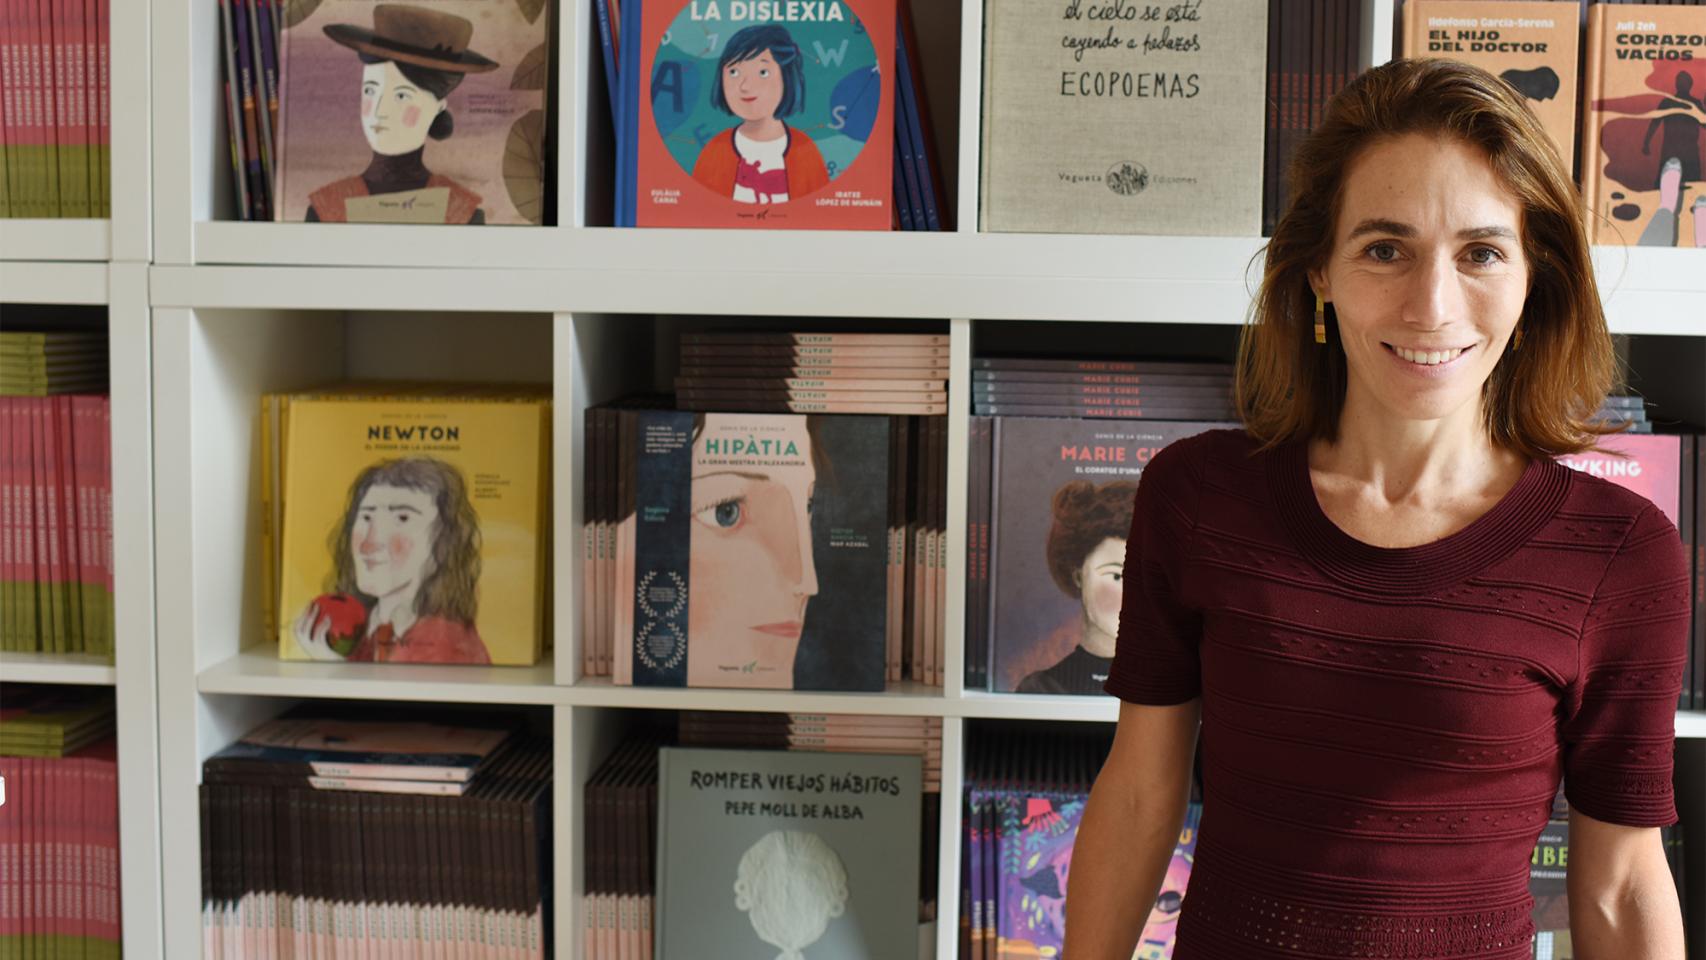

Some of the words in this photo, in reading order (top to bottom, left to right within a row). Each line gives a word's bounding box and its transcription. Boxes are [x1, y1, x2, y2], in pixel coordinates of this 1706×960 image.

[691, 0, 721, 21] LA
[730, 1, 843, 22] DISLEXIA
[1063, 0, 1082, 21] el
[1088, 0, 1137, 20] cielo
[1140, 5, 1161, 21] se
[1062, 25, 1123, 62] cayendo
[1126, 38, 1138, 49] a
[1142, 25, 1200, 55] pedazos
[1428, 30, 1450, 40] EL
[1457, 31, 1500, 41] HIJO
[1616, 33, 1706, 46] CORAZO
[1428, 42, 1464, 52] DEL
[1471, 43, 1548, 53] DOCTOR
[1615, 46, 1694, 61] VACÍOS
[1061, 71, 1200, 99] ECOPOEMAS
[1058, 173, 1102, 184] Vegueta
[1153, 174, 1198, 185] Ediciones
[368, 424, 459, 441] NEWTON
[705, 434, 799, 456] HIPÀTIA
[1061, 445, 1126, 462] MARIE
[1556, 459, 1643, 478] WKING
[690, 770, 762, 790] ROMPER
[768, 773, 825, 793] VIEJOS
[829, 772, 900, 796] HÁBITOS
[725, 801, 755, 816] PEPE
[760, 802, 798, 818] MOLL
[802, 804, 819, 819] DE
[822, 804, 864, 820] ALBA
